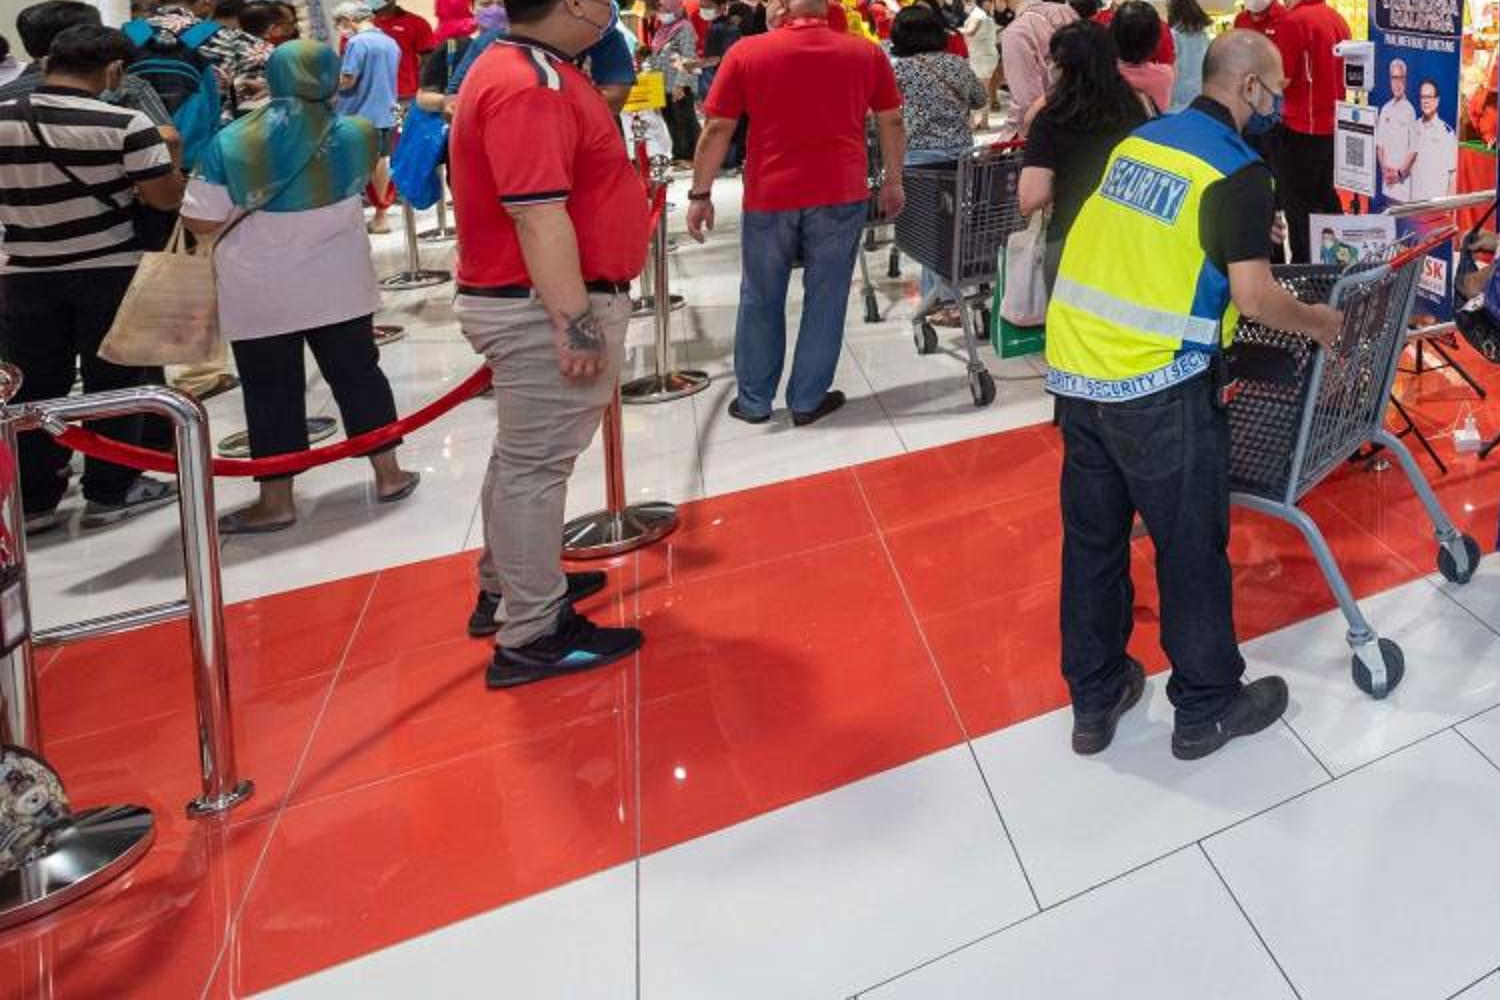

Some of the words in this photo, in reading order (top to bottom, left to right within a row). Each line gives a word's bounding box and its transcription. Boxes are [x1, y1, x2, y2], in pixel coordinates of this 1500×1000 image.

[1103, 160, 1184, 217] SECURITY
[1424, 258, 1443, 281] SK
[1087, 374, 1155, 397] SECURITY
